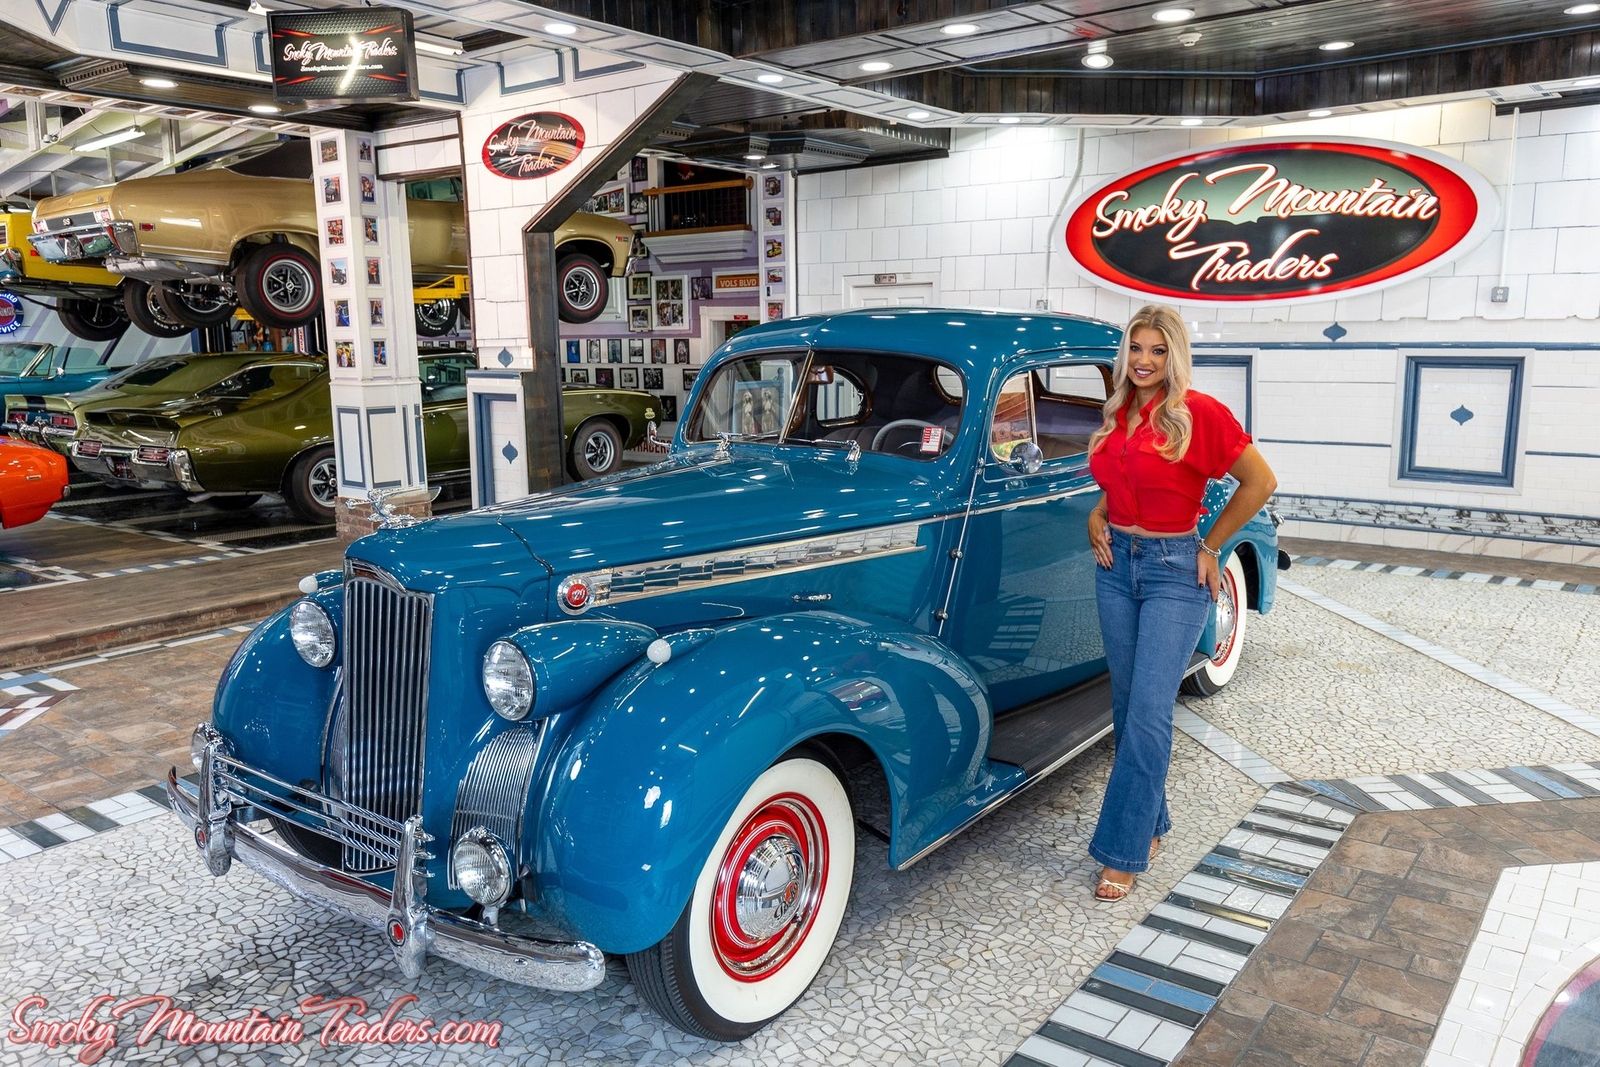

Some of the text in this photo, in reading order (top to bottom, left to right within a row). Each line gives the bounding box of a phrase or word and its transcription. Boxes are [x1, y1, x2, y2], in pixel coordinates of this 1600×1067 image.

[283, 40, 314, 66] Smoky
[358, 37, 398, 60] Traders
[517, 119, 577, 142] Mountain
[511, 146, 556, 177] Traders
[1092, 162, 1441, 242] Smoky Mountain
[1168, 228, 1341, 291] Traders
[720, 278, 757, 288] VOLS BLVD
